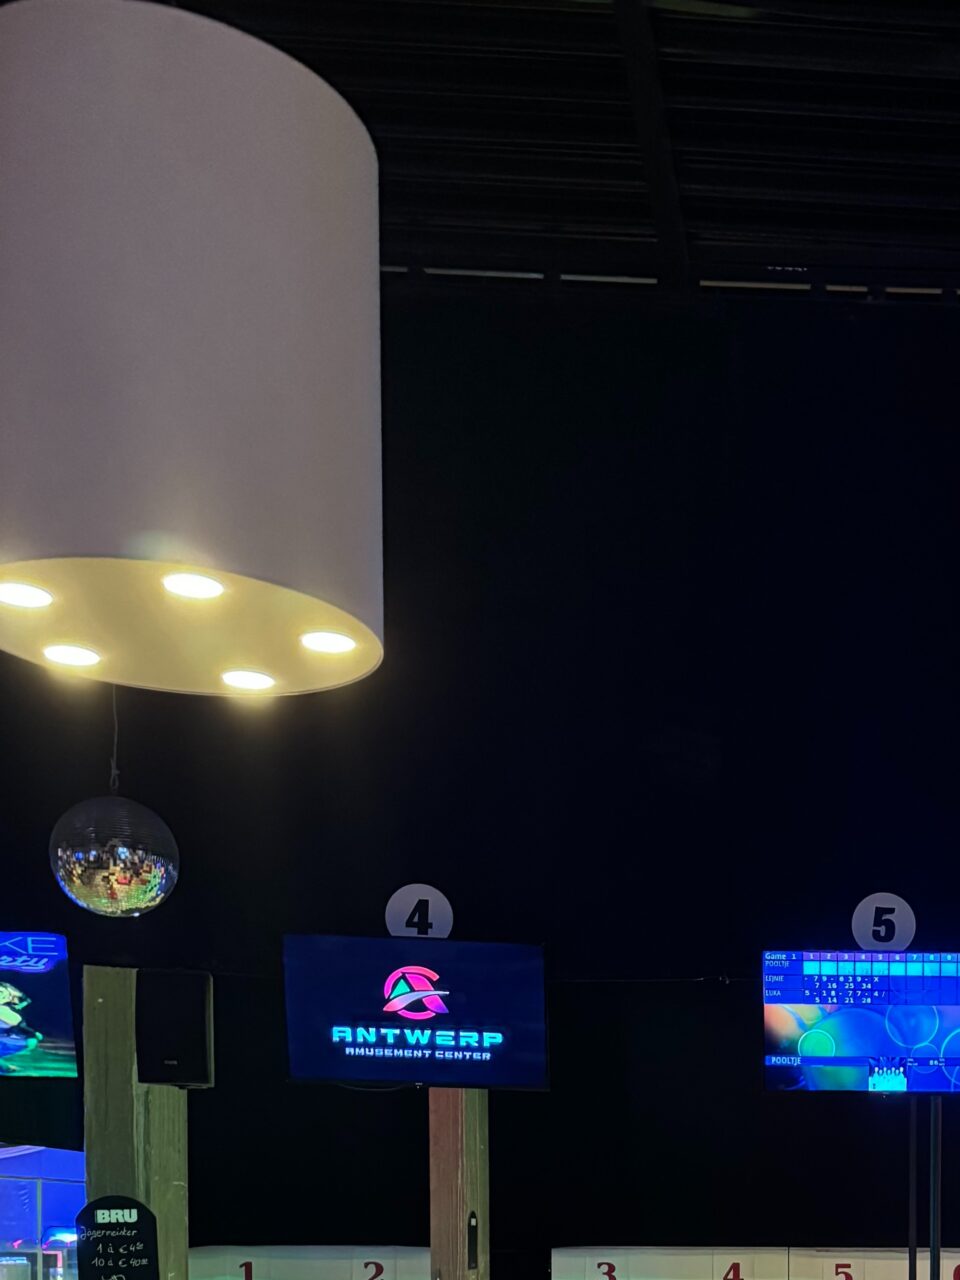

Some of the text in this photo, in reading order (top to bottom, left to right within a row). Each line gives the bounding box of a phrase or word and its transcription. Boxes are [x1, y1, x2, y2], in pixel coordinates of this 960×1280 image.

[405, 898, 434, 936] 4
[871, 906, 896, 943] 5
[765, 952, 786, 960] Game
[331, 1026, 504, 1047] ANTWERP
[345, 1047, 491, 1061] AMUSEMENT CENTER
[96, 1208, 138, 1224] BRU
